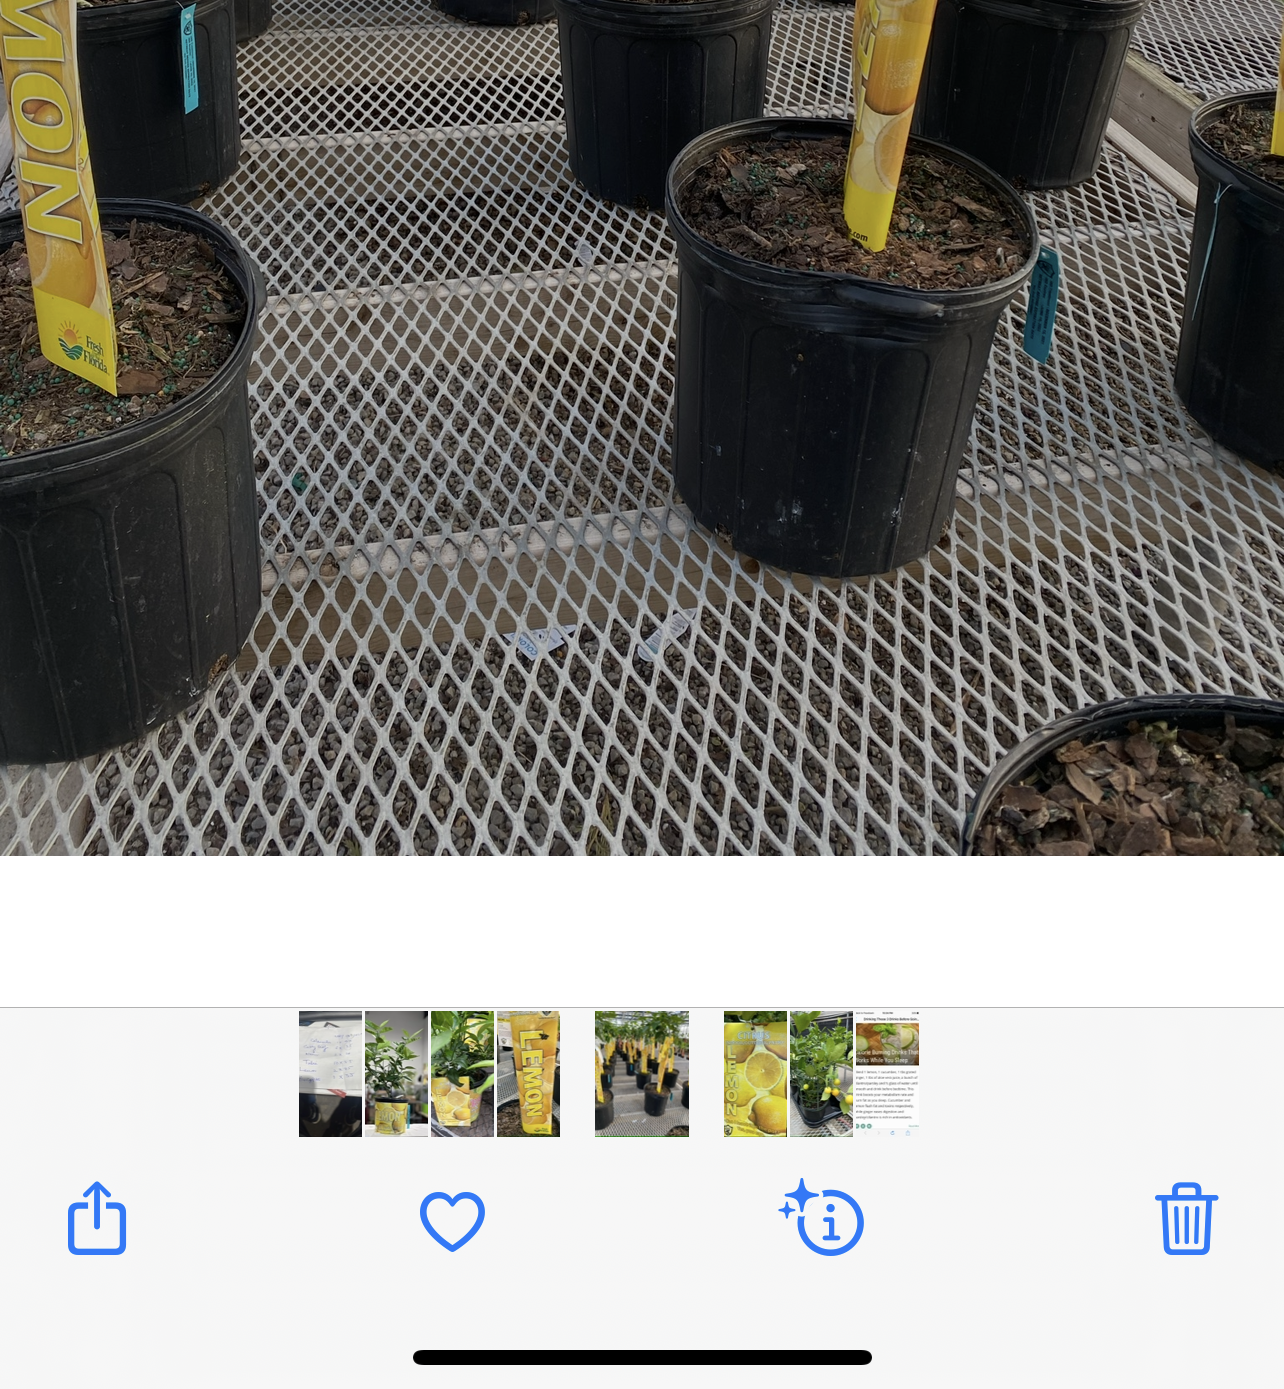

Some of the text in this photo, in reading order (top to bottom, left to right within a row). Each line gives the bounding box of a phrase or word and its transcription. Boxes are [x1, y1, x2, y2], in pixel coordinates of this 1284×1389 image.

[85, 334, 105, 357] Fresh
[82, 349, 109, 376] Florida
[737, 1030, 771, 1040] CITRUS
[519, 1030, 544, 1117] LEMON
[724, 1044, 739, 1117] LEMON
